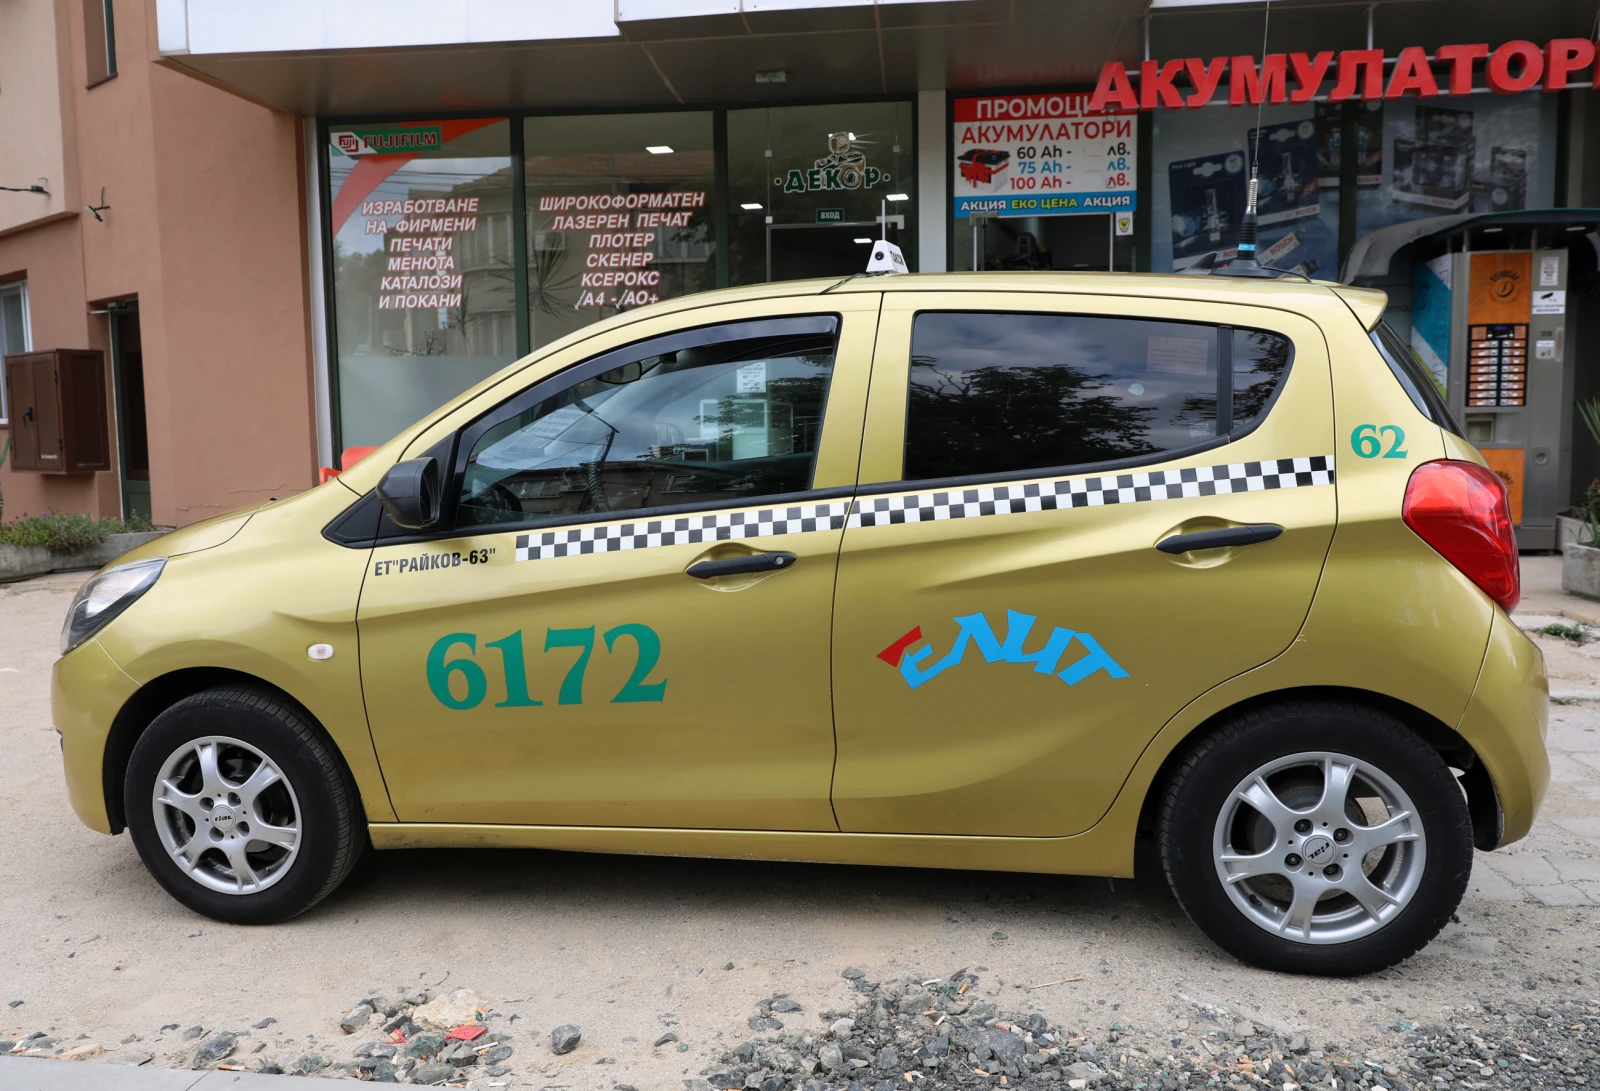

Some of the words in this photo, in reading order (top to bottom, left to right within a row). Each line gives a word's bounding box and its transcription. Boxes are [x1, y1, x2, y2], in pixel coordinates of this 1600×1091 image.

[1088, 37, 1600, 111] АКУМУЛАТОР
[977, 95, 1114, 119] ПРОМОЦ
[363, 132, 437, 148] FUJIFILM
[961, 120, 1131, 144] АКУМУЛАТОРИ
[1017, 146, 1036, 159] 60
[1040, 145, 1062, 158] Ah
[1018, 161, 1036, 174] 75
[1040, 160, 1062, 173] Ah
[784, 167, 881, 193] ДЕКОР
[1010, 177, 1036, 190] 100
[1040, 176, 1062, 189] Ah
[362, 198, 479, 215] ИЗРАБОТВАНЕ
[539, 192, 705, 211] ШИРОКОФОРМАТЕН
[961, 200, 1006, 212] АКЦИЯ
[1011, 199, 1037, 210] ЕКО
[1041, 198, 1078, 210] ЦЕНА
[1083, 196, 1130, 208] АКЦИЯ
[552, 214, 629, 230] ЛАЗЕРЕН
[636, 212, 692, 228] ПЕЧАТ
[821, 212, 840, 220] ВХОД
[365, 220, 388, 234] НА
[395, 217, 477, 233] ФИРМЕНИ
[390, 237, 453, 252] ПЕЧАТИ
[589, 233, 655, 248] ПЛОТЕР
[1269, 235, 1295, 255] BOSCH
[586, 253, 654, 267] СКЕНЕР
[1223, 250, 1238, 258] BOS
[388, 256, 455, 271] МЕНЮТА
[381, 275, 463, 290] КАТАЛОЗИ
[581, 271, 660, 286] КСЕРОКС
[379, 295, 390, 309] И
[395, 294, 462, 308] ПОКАНИ
[1350, 424, 1408, 459] 62
[426, 623, 668, 710] 6172
